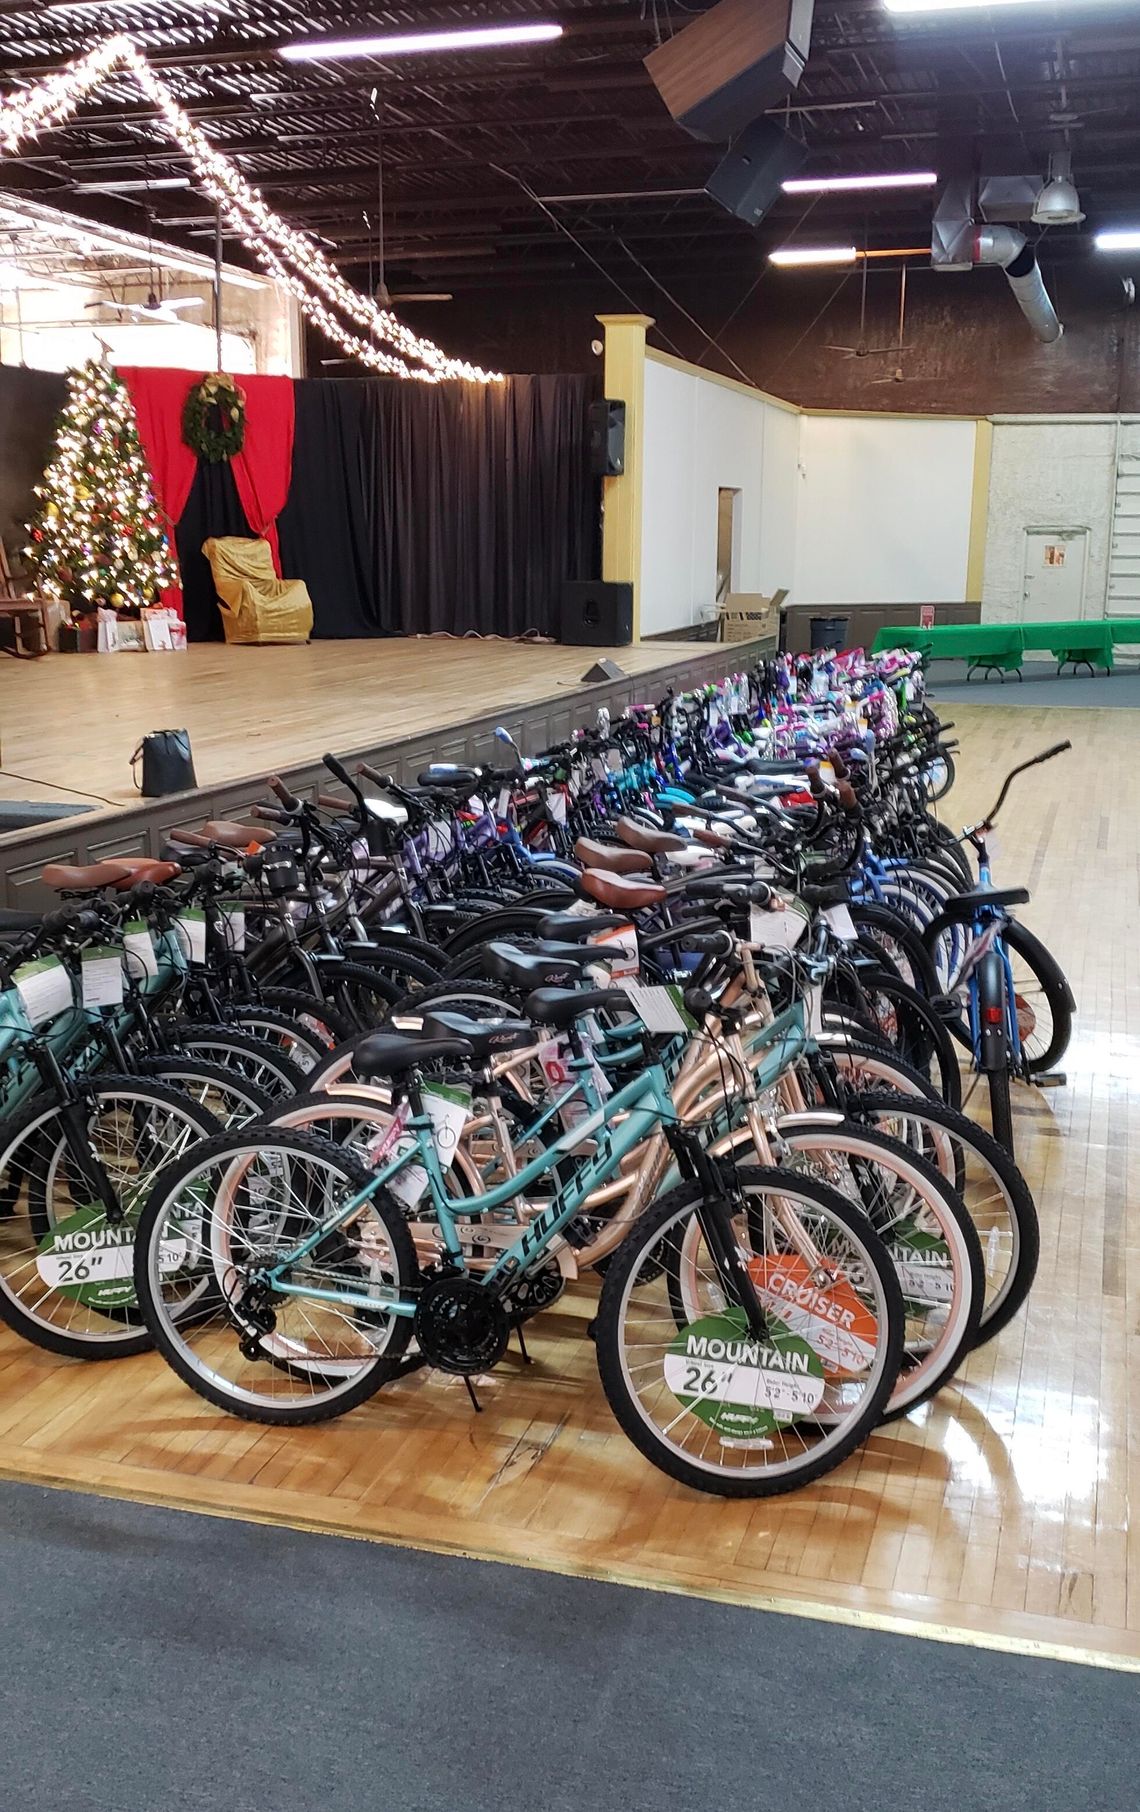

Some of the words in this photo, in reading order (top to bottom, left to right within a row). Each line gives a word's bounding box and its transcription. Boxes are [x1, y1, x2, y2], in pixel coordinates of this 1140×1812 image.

[521, 1137, 613, 1257] HUFFY
[57, 1256, 103, 1283] 26"
[686, 1335, 809, 1373] MOUNTAIN
